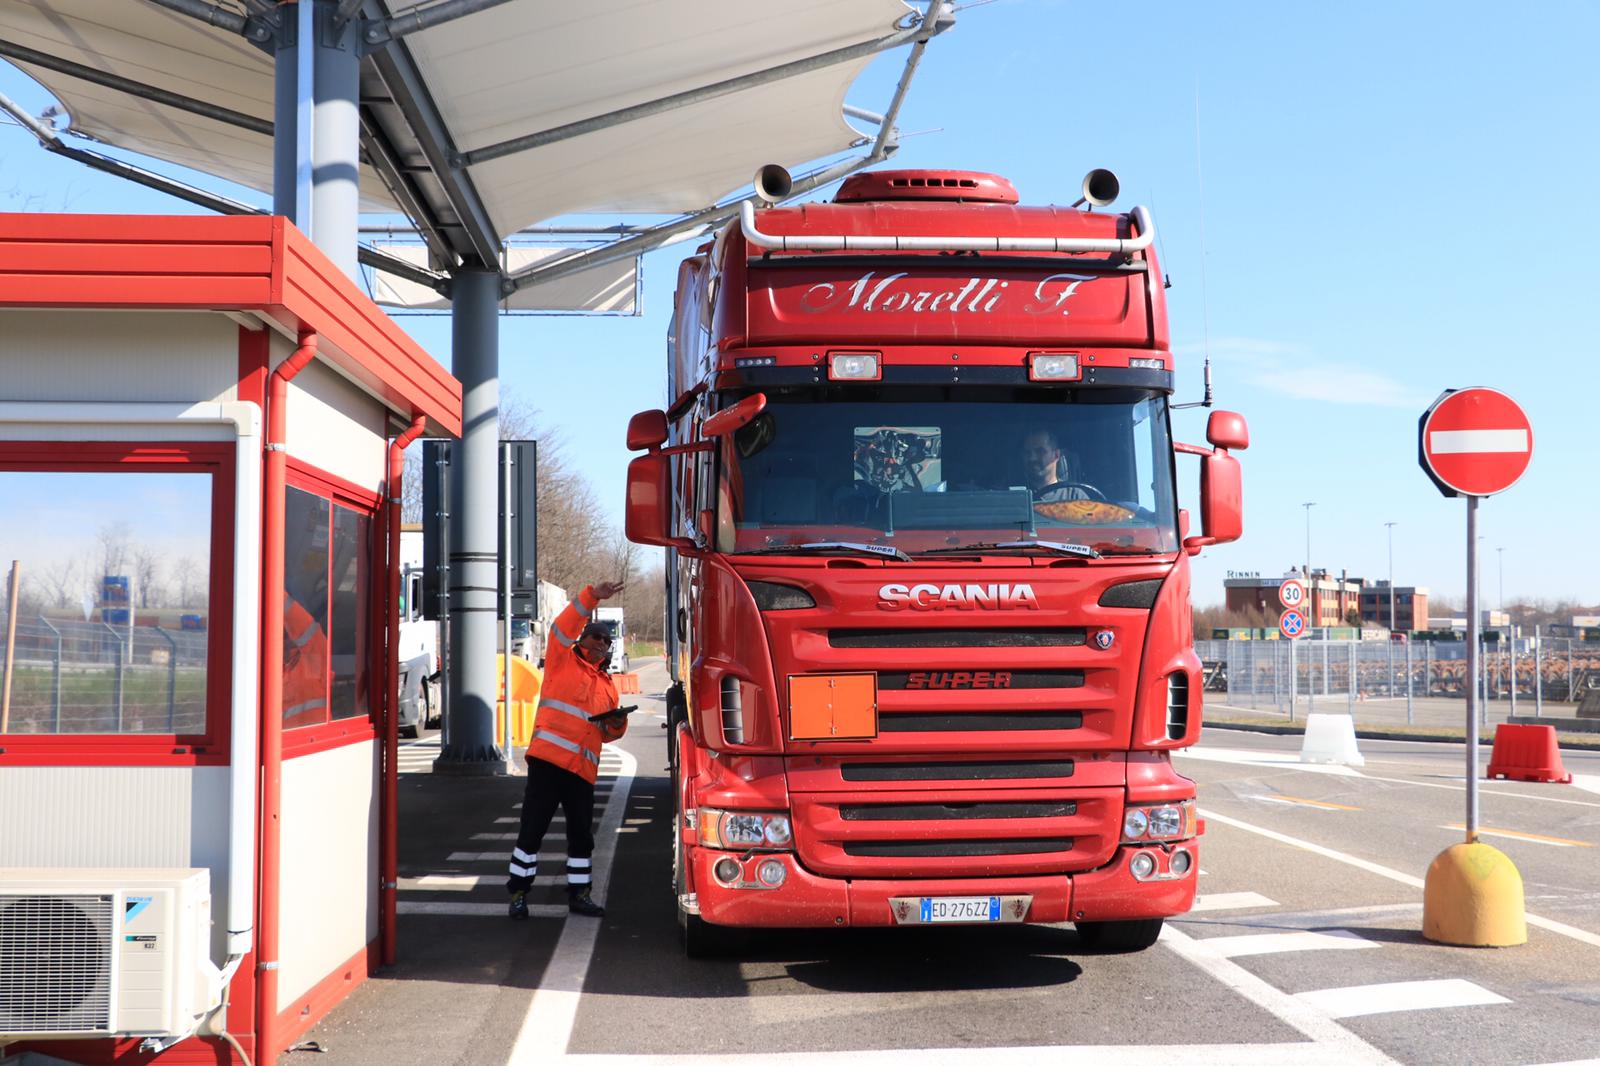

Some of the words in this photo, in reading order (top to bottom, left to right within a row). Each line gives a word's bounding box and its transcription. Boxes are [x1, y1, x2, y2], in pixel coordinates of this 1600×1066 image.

[801, 271, 1009, 313] Morelli
[865, 543, 893, 553] SUPER
[1061, 543, 1088, 553] SUPER
[878, 583, 1039, 611] SCANIA
[1285, 587, 1300, 600] 30
[906, 671, 1012, 689] SUPER
